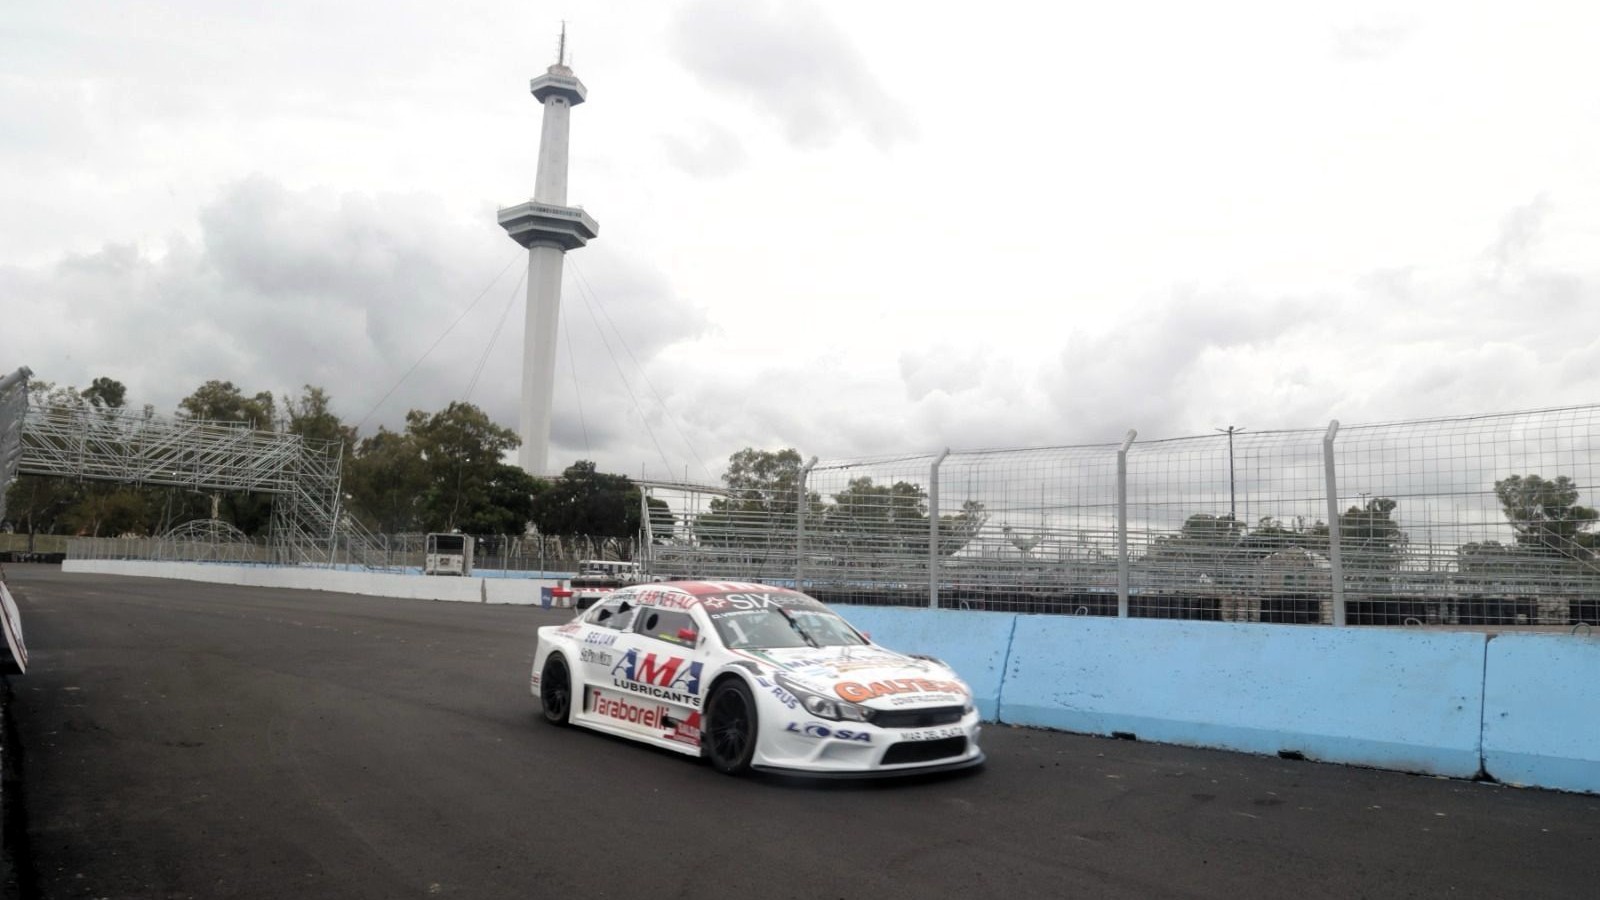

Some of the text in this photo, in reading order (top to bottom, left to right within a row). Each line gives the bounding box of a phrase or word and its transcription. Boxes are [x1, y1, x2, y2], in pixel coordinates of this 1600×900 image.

[611, 648, 704, 695] AMA
[592, 691, 670, 730] Taraborelli
[614, 678, 701, 706] LUBRICANTS
